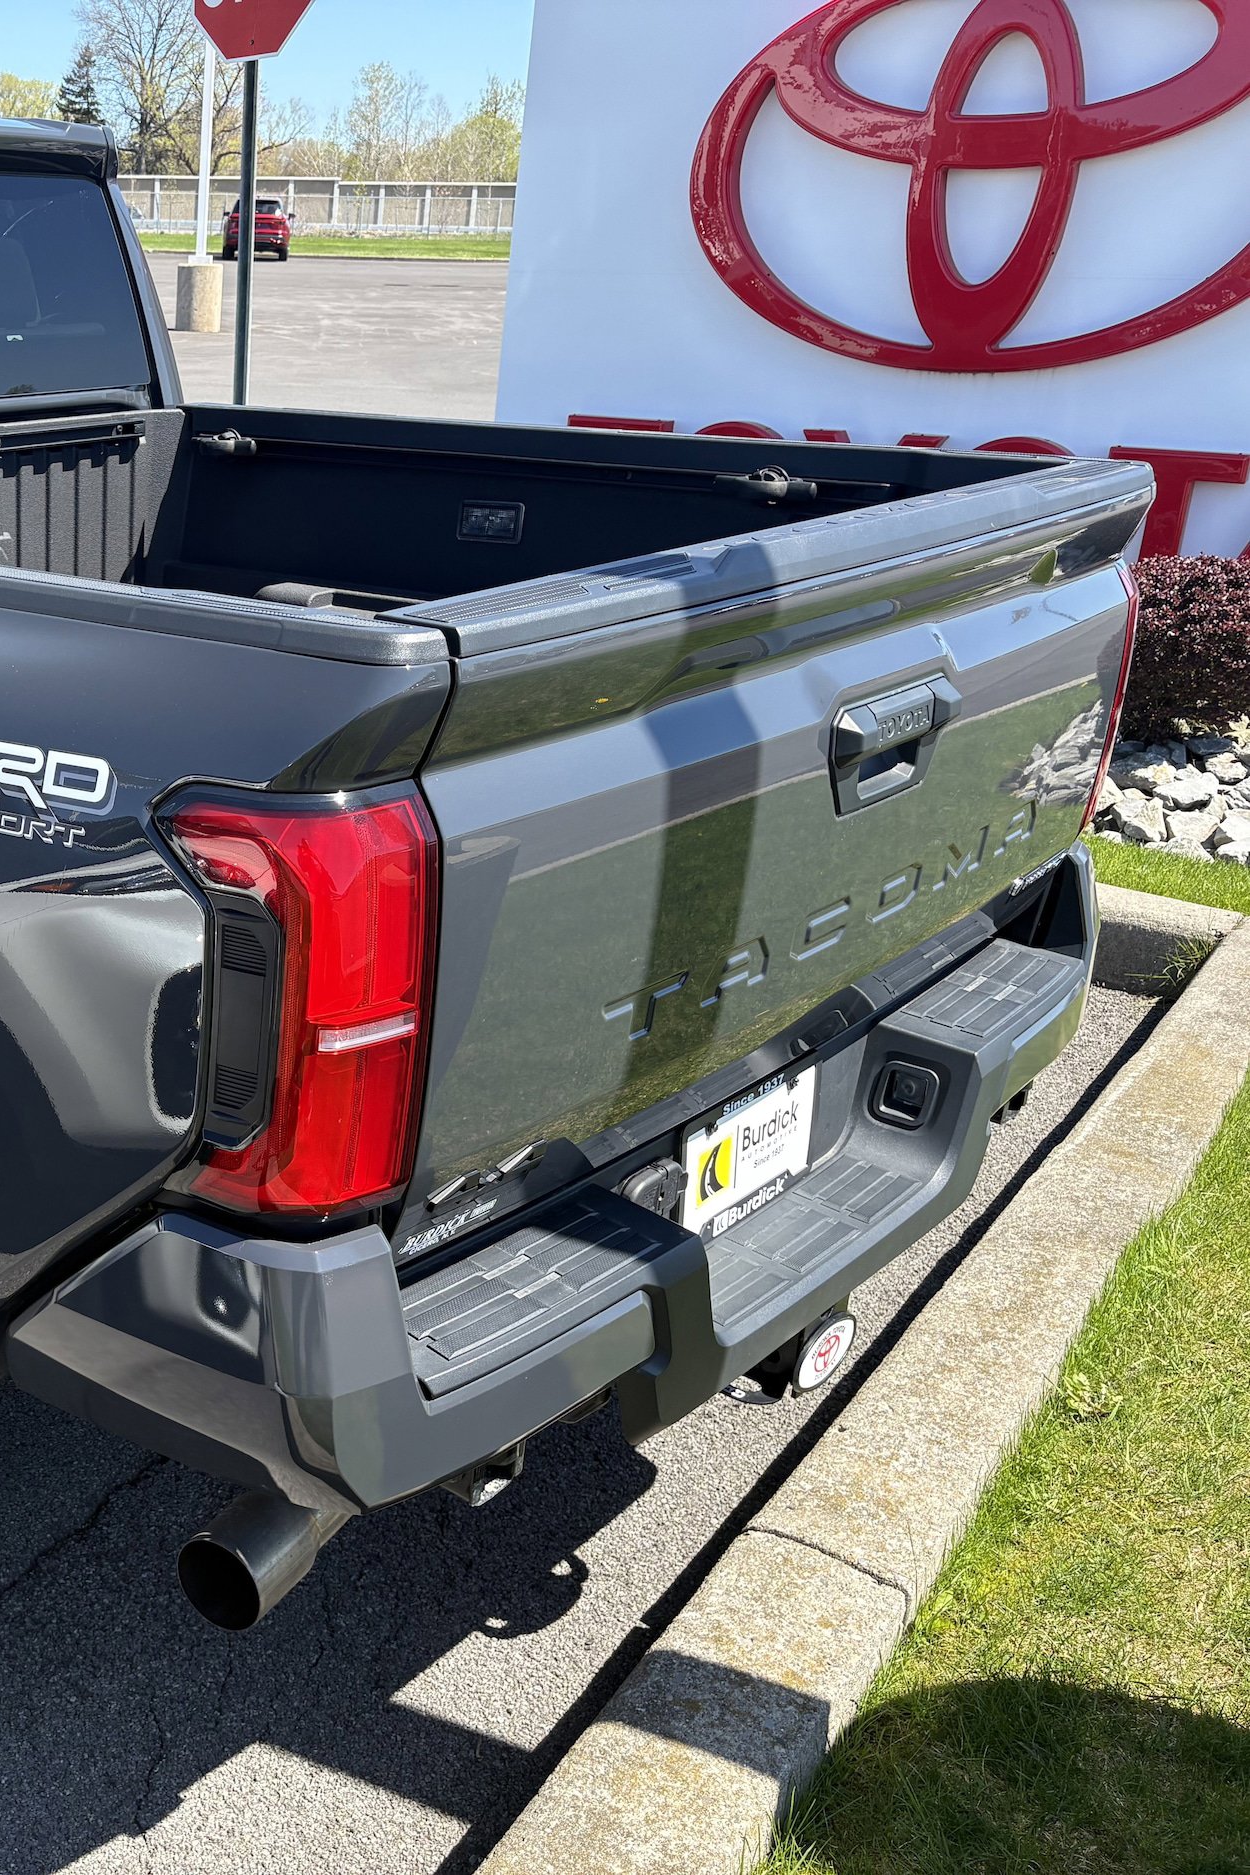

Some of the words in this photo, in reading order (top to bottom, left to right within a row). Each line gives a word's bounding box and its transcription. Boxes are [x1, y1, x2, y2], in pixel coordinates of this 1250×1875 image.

[878, 704, 930, 742] TOYOTA
[602, 800, 1037, 1041] TACOMA
[722, 1092, 755, 1116] Since
[757, 1073, 785, 1096] 1937
[741, 1100, 799, 1152] Burdick
[741, 1125, 798, 1163] AUTOMOTIVE
[727, 1177, 785, 1226] Burdick
[398, 1208, 472, 1255] BURDICK
